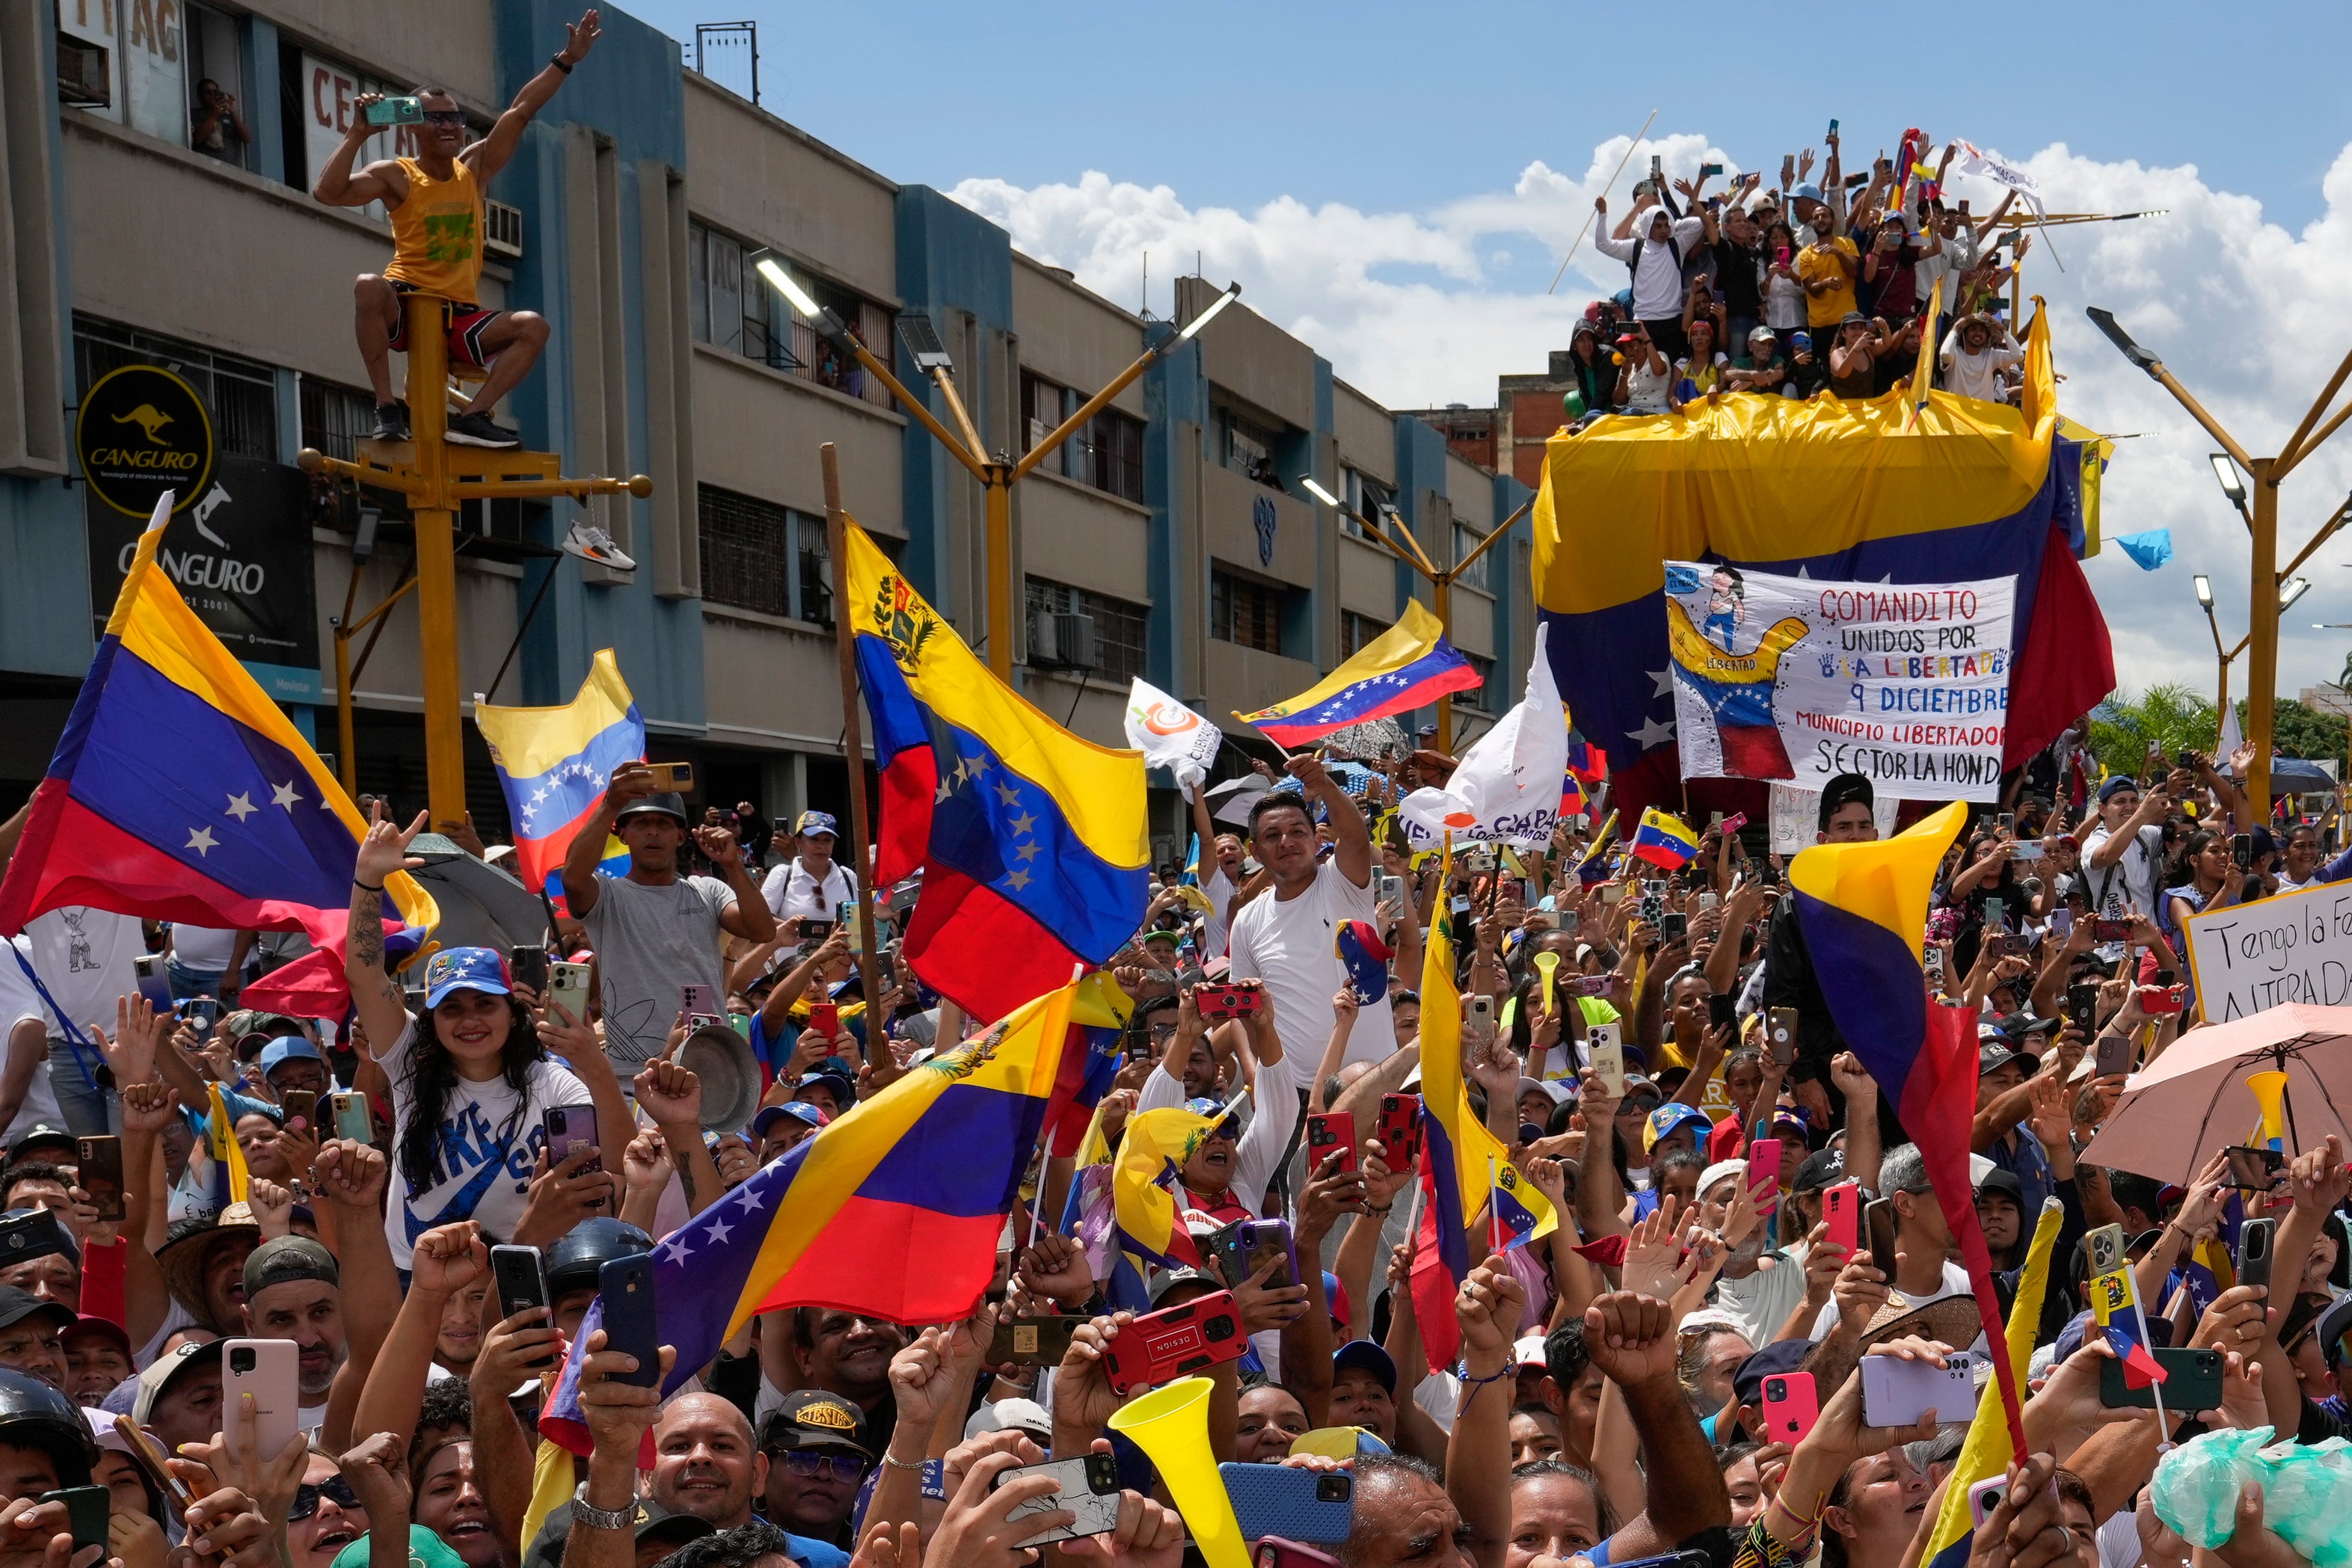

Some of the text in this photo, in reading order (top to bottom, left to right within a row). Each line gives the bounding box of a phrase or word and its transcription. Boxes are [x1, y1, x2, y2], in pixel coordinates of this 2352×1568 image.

[90, 448, 198, 470] CANGURO
[118, 542, 264, 594] CNGURO
[1820, 589, 1977, 623] COMANDITO
[1841, 625, 1977, 654] UNIDOS POR
[1707, 657, 1757, 671] LIBERTAD
[1841, 651, 1993, 678] LA LIBERTAD
[1851, 683, 2008, 713] 9 DICIEMBRE
[1796, 711, 1884, 740] MUNICIPIO
[1815, 739, 2001, 785] SECTOR LA HOND
[2203, 922, 2297, 971] Tengo
[2306, 904, 2325, 946] la
[1157, 1335, 1191, 1351] DESIGN
[802, 1408, 847, 1427] JESUS
[1025, 1418, 1053, 1430] OAKLE
